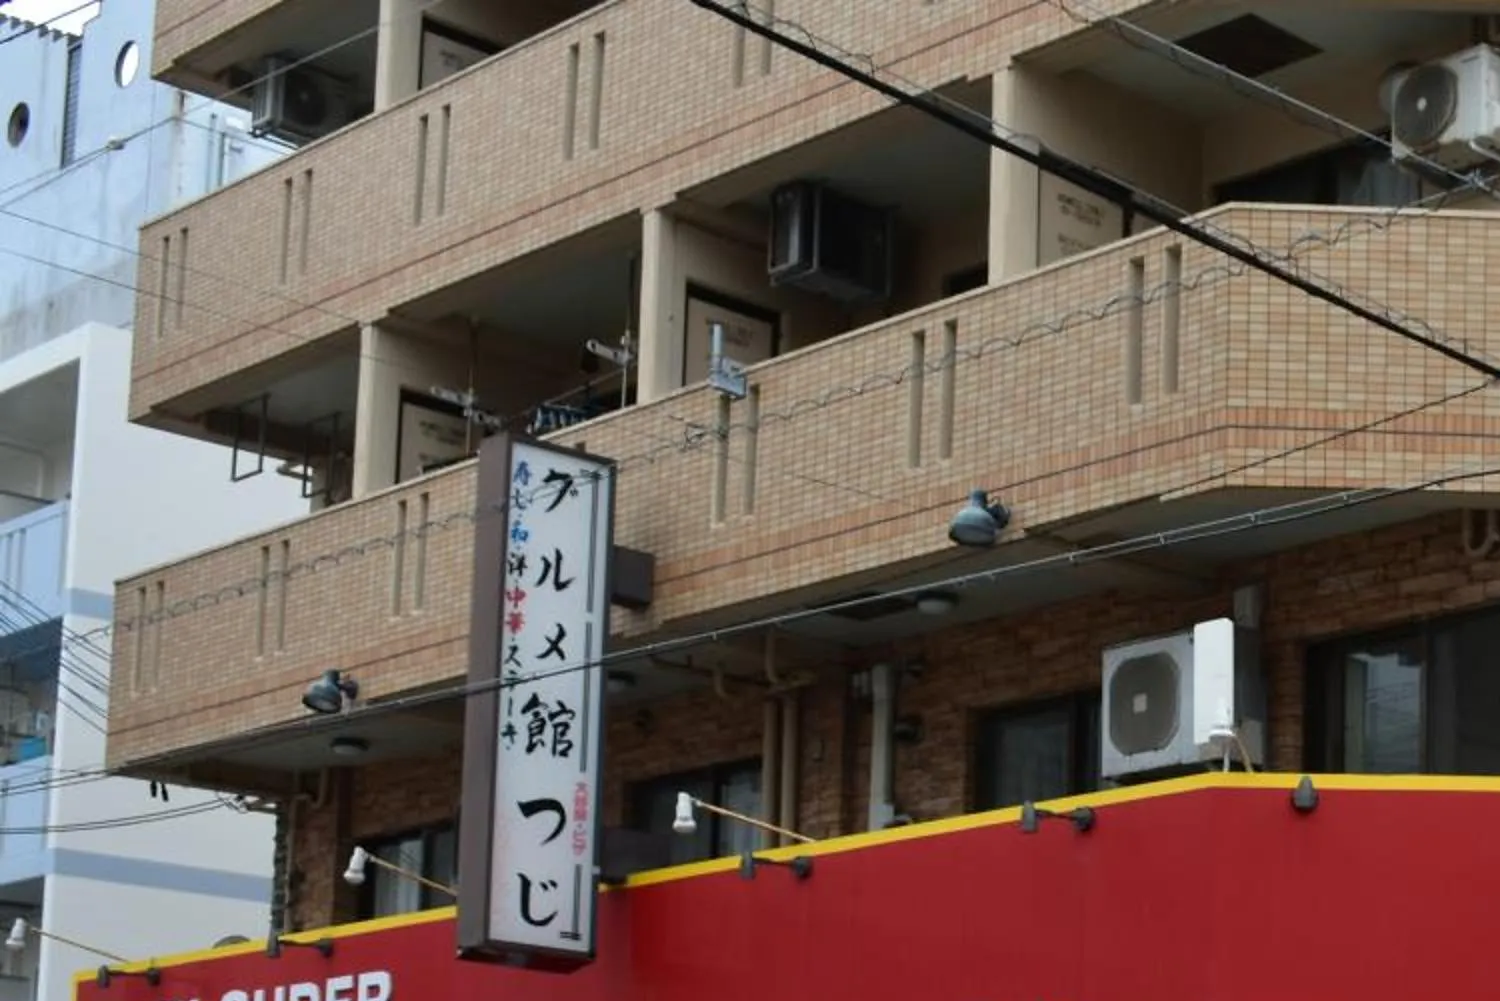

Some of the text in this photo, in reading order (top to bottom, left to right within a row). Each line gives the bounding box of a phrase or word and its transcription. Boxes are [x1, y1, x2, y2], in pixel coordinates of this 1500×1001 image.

[517, 468, 579, 928] グルメ館つじ
